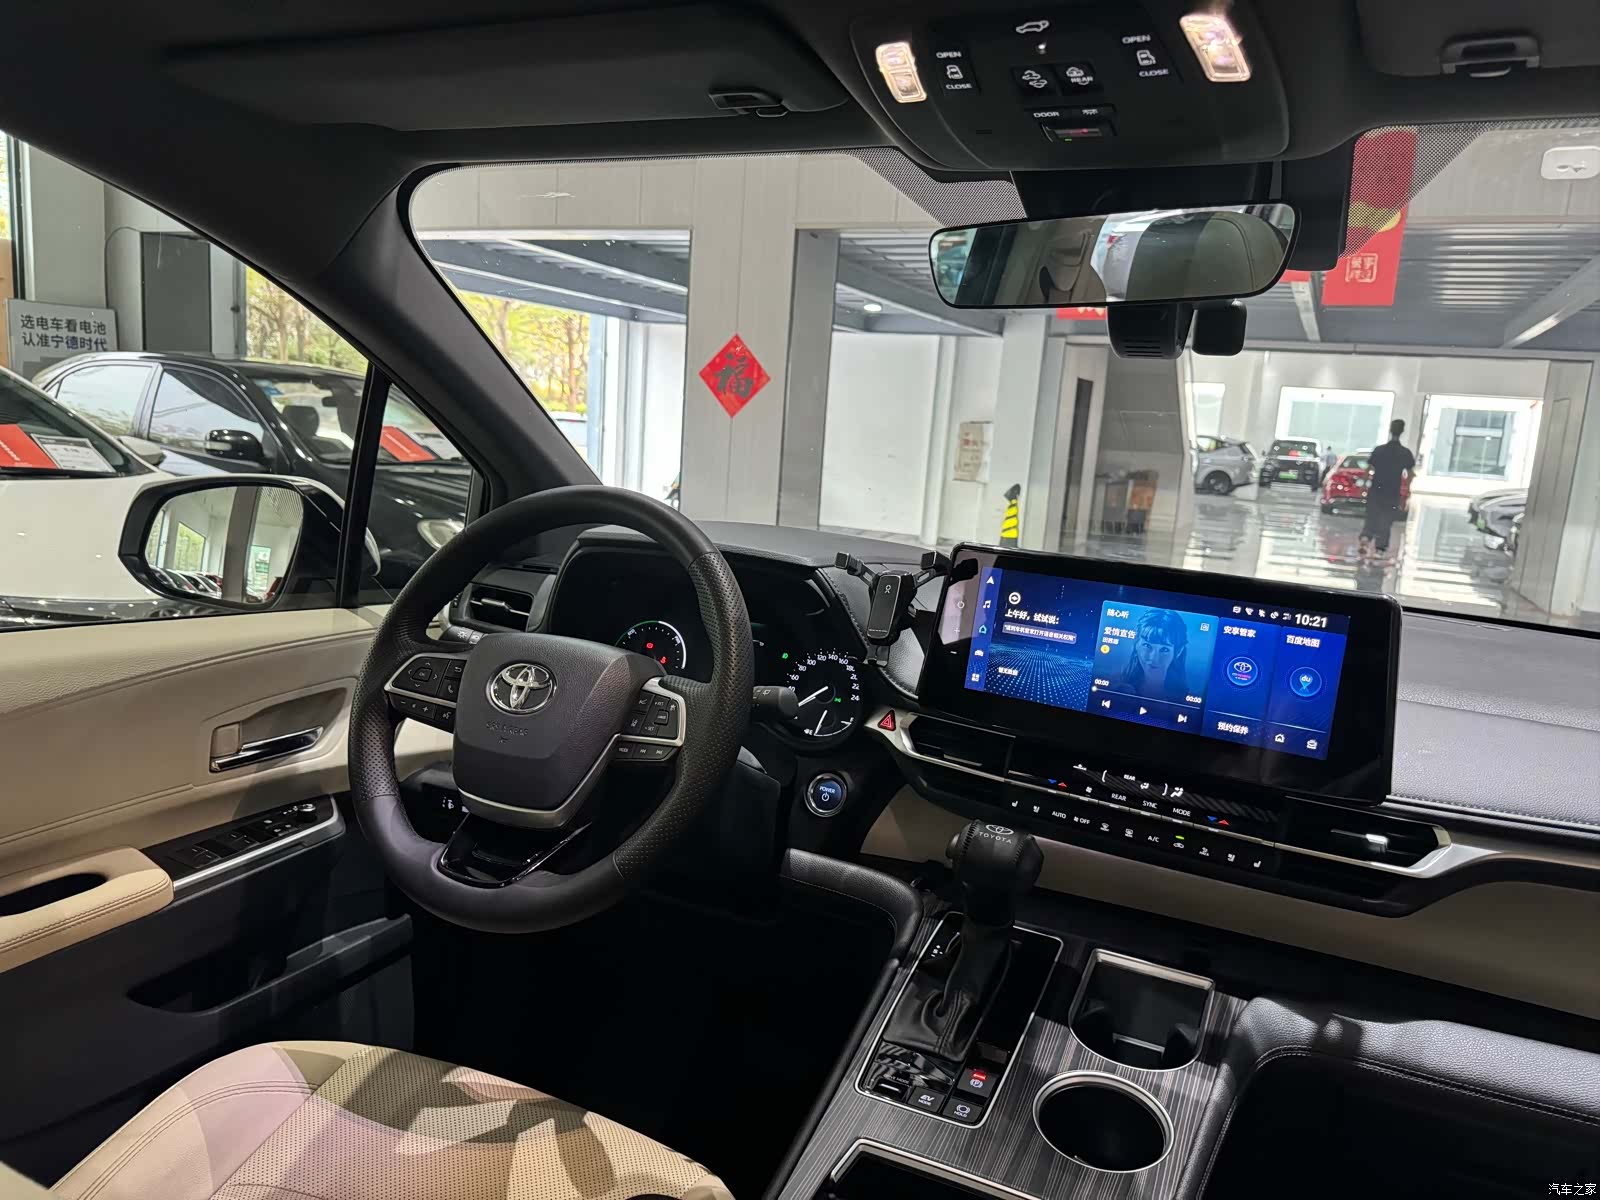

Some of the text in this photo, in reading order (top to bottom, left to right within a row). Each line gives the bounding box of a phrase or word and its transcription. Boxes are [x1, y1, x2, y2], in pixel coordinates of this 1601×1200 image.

[1121, 34, 1151, 44] OPEN
[1138, 68, 1169, 77] CLOSE
[945, 82, 972, 90] CLOSE
[20, 314, 107, 336] 选电车看电池
[22, 332, 108, 352] 认准宁德时代
[714, 352, 754, 399] 福
[1295, 613, 1328, 628] 10:21
[1223, 625, 1256, 638] 安享管家
[1286, 634, 1321, 648] 百度地图
[828, 653, 838, 661] 140
[1185, 694, 1202, 703] 00:00
[1217, 721, 1249, 735] 预约保养
[819, 786, 836, 794] POWER
[1111, 793, 1127, 801] REAR
[1142, 800, 1158, 809] SYNC
[1052, 811, 1067, 819] AUTO
[1172, 807, 1191, 817] MODE
[1079, 817, 1091, 825] OFF
[979, 831, 1012, 844] TOYOTA
[1148, 835, 1160, 843] A/C
[953, 1110, 968, 1118] HOLD
